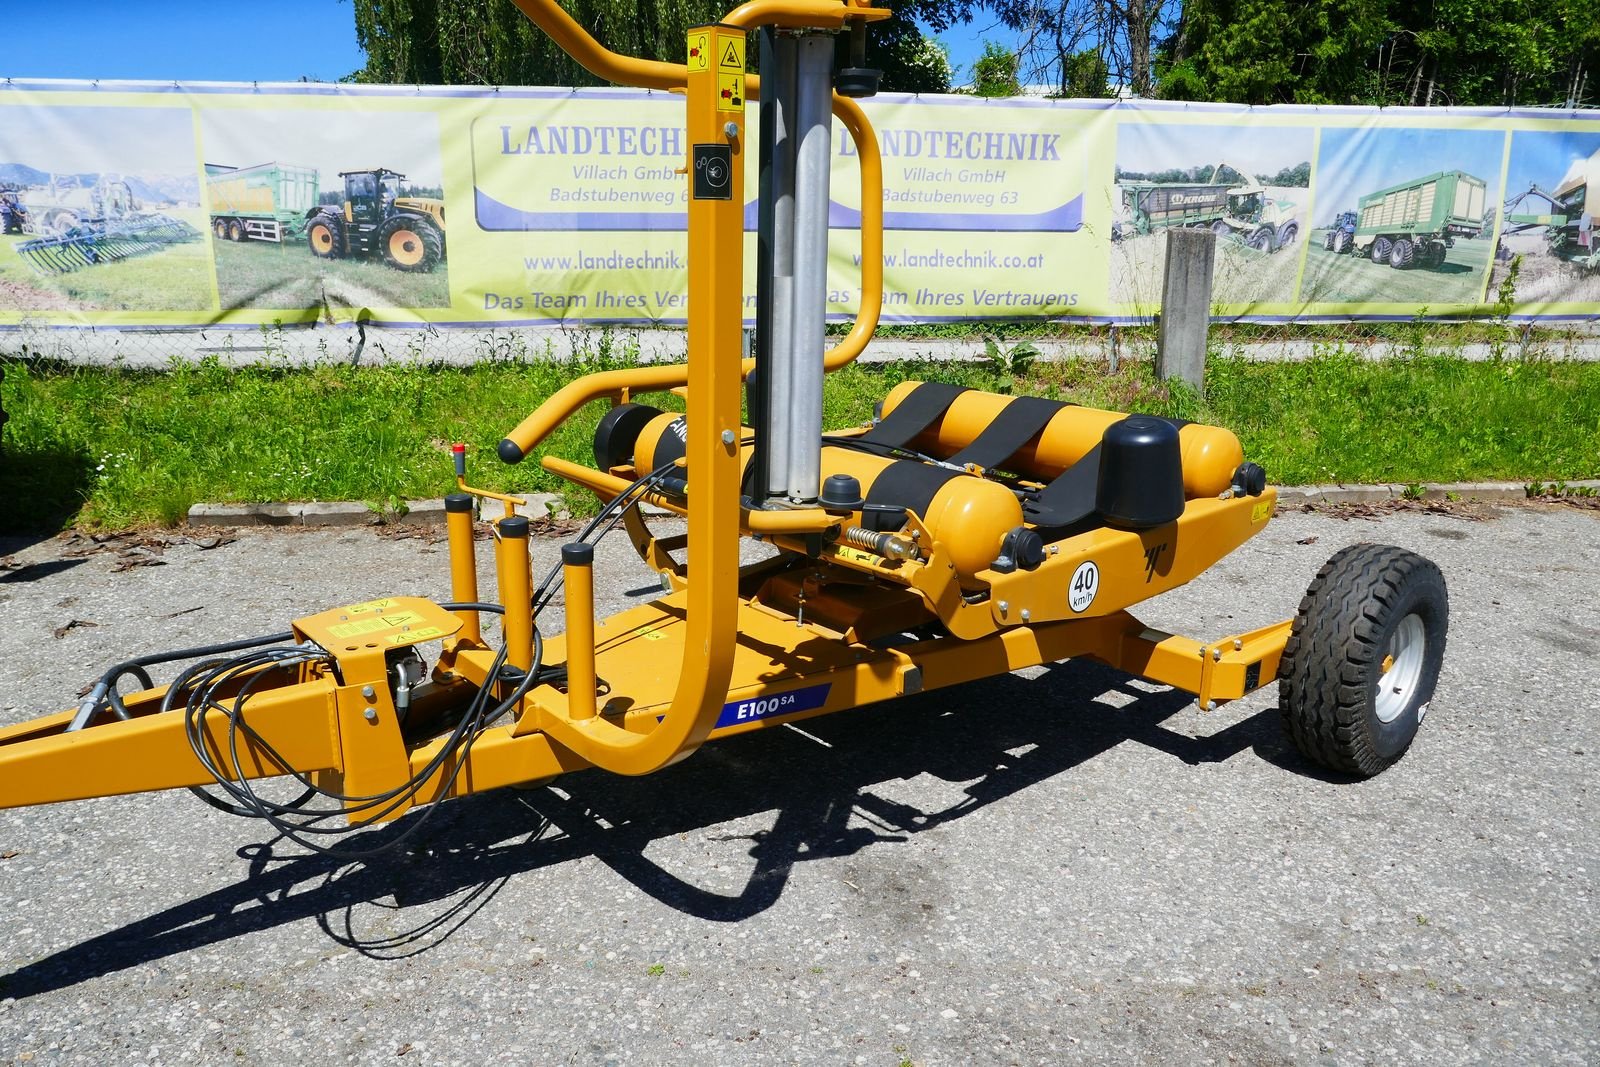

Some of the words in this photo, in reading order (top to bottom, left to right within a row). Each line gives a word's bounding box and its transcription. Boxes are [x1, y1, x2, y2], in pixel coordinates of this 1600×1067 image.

[500, 125, 687, 156] LANDTECH
[838, 128, 1061, 161] LNDTECHNIK
[572, 165, 627, 180] Villach
[903, 167, 952, 183] Villach
[958, 169, 1006, 184] GmbH
[550, 187, 676, 206] Badstubenweg
[882, 187, 994, 207] Badstubenweg
[1000, 190, 1018, 205] 63
[1183, 194, 1217, 204] KRONE
[853, 248, 1044, 269] ww.landtechnik.co.at
[484, 292, 524, 310] Das
[531, 291, 587, 309] Team
[595, 290, 647, 309] Ihres
[828, 289, 850, 303] as
[915, 288, 965, 306] Ihres
[972, 289, 1078, 307] Vertrauens
[1074, 567, 1095, 593] 40
[1072, 591, 1093, 608] km/h
[737, 698, 780, 720] E100
[780, 694, 796, 706] SA
